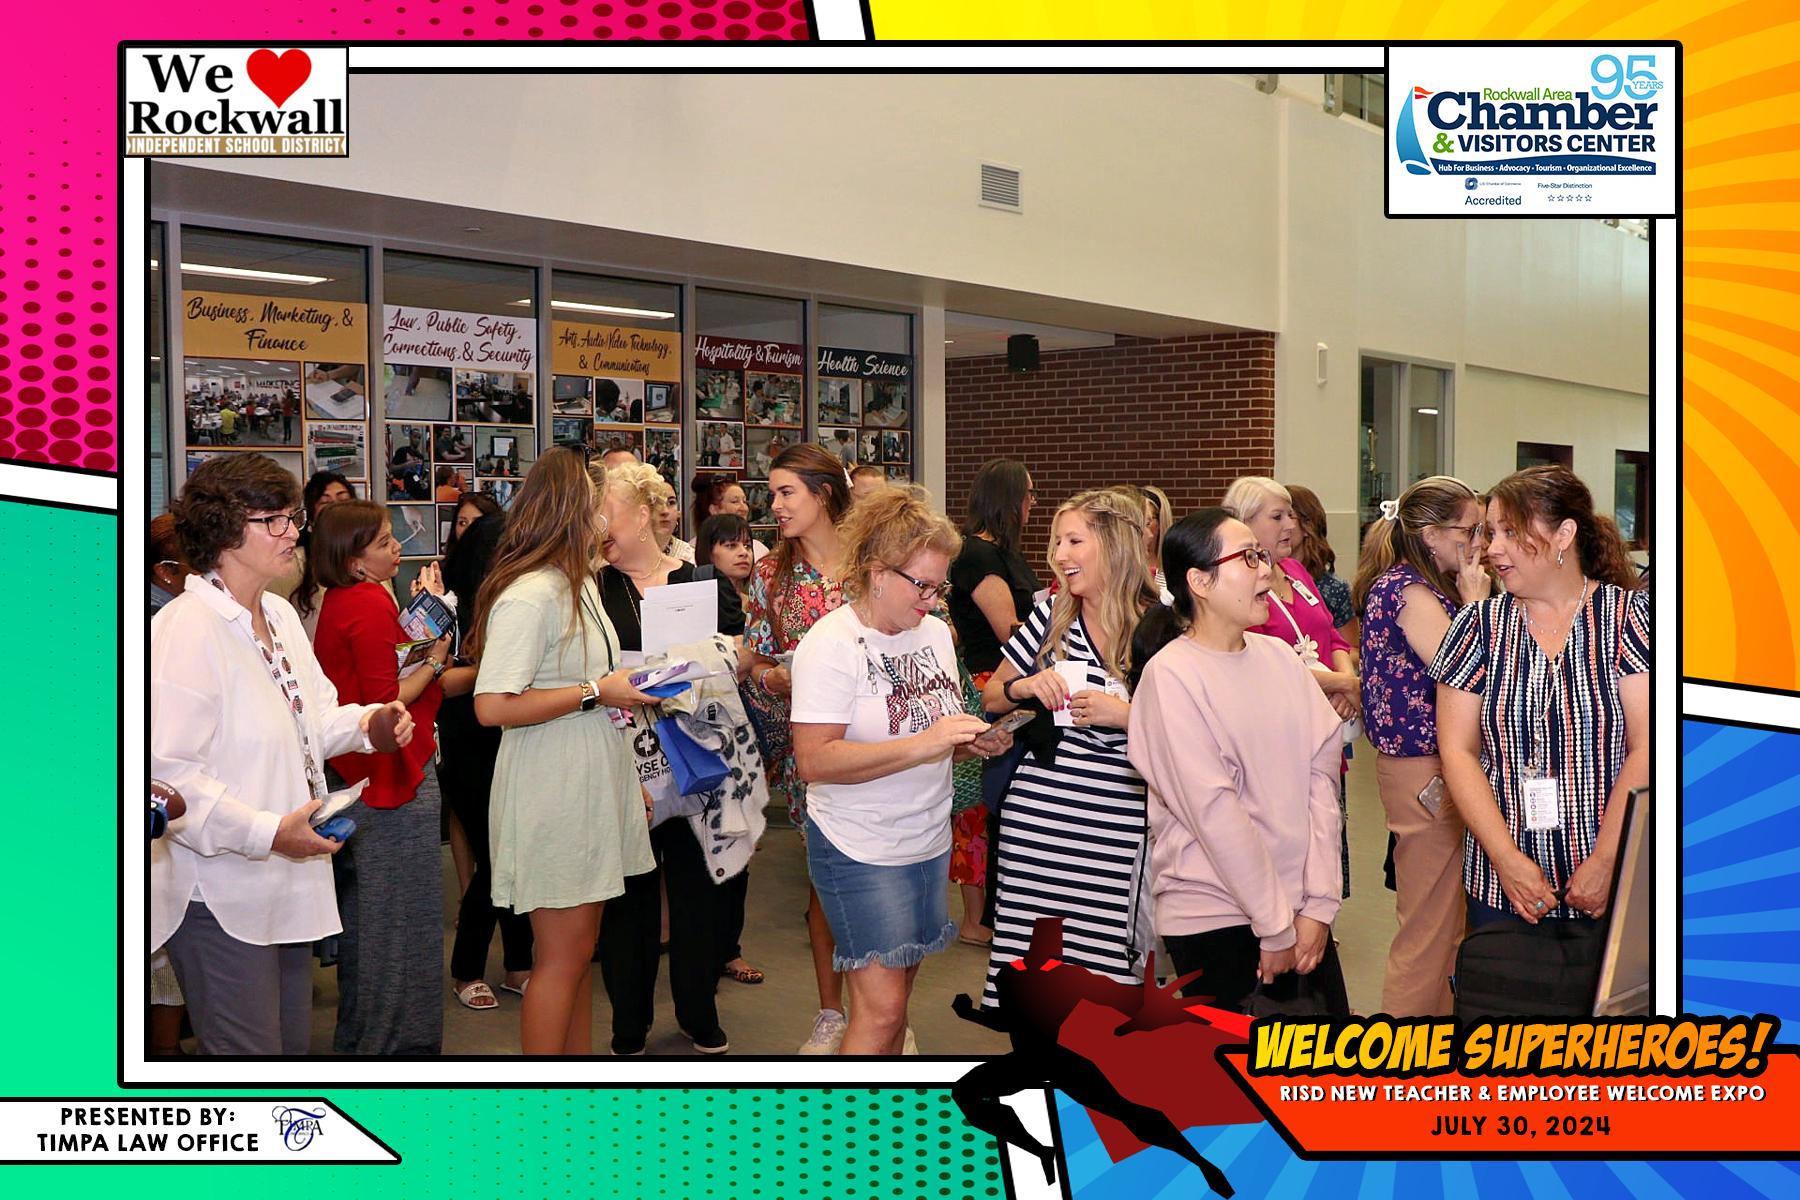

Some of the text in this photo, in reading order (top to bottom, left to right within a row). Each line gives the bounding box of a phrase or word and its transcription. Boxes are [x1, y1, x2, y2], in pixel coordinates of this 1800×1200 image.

[342, 308, 353, 327] &
[427, 311, 469, 334] Public
[244, 328, 310, 351] Finance
[462, 341, 474, 362] &
[476, 341, 533, 371] Security
[578, 352, 651, 376] & Communications
[694, 336, 803, 369] Hospitality & Tourism
[817, 350, 909, 377] Health Science
